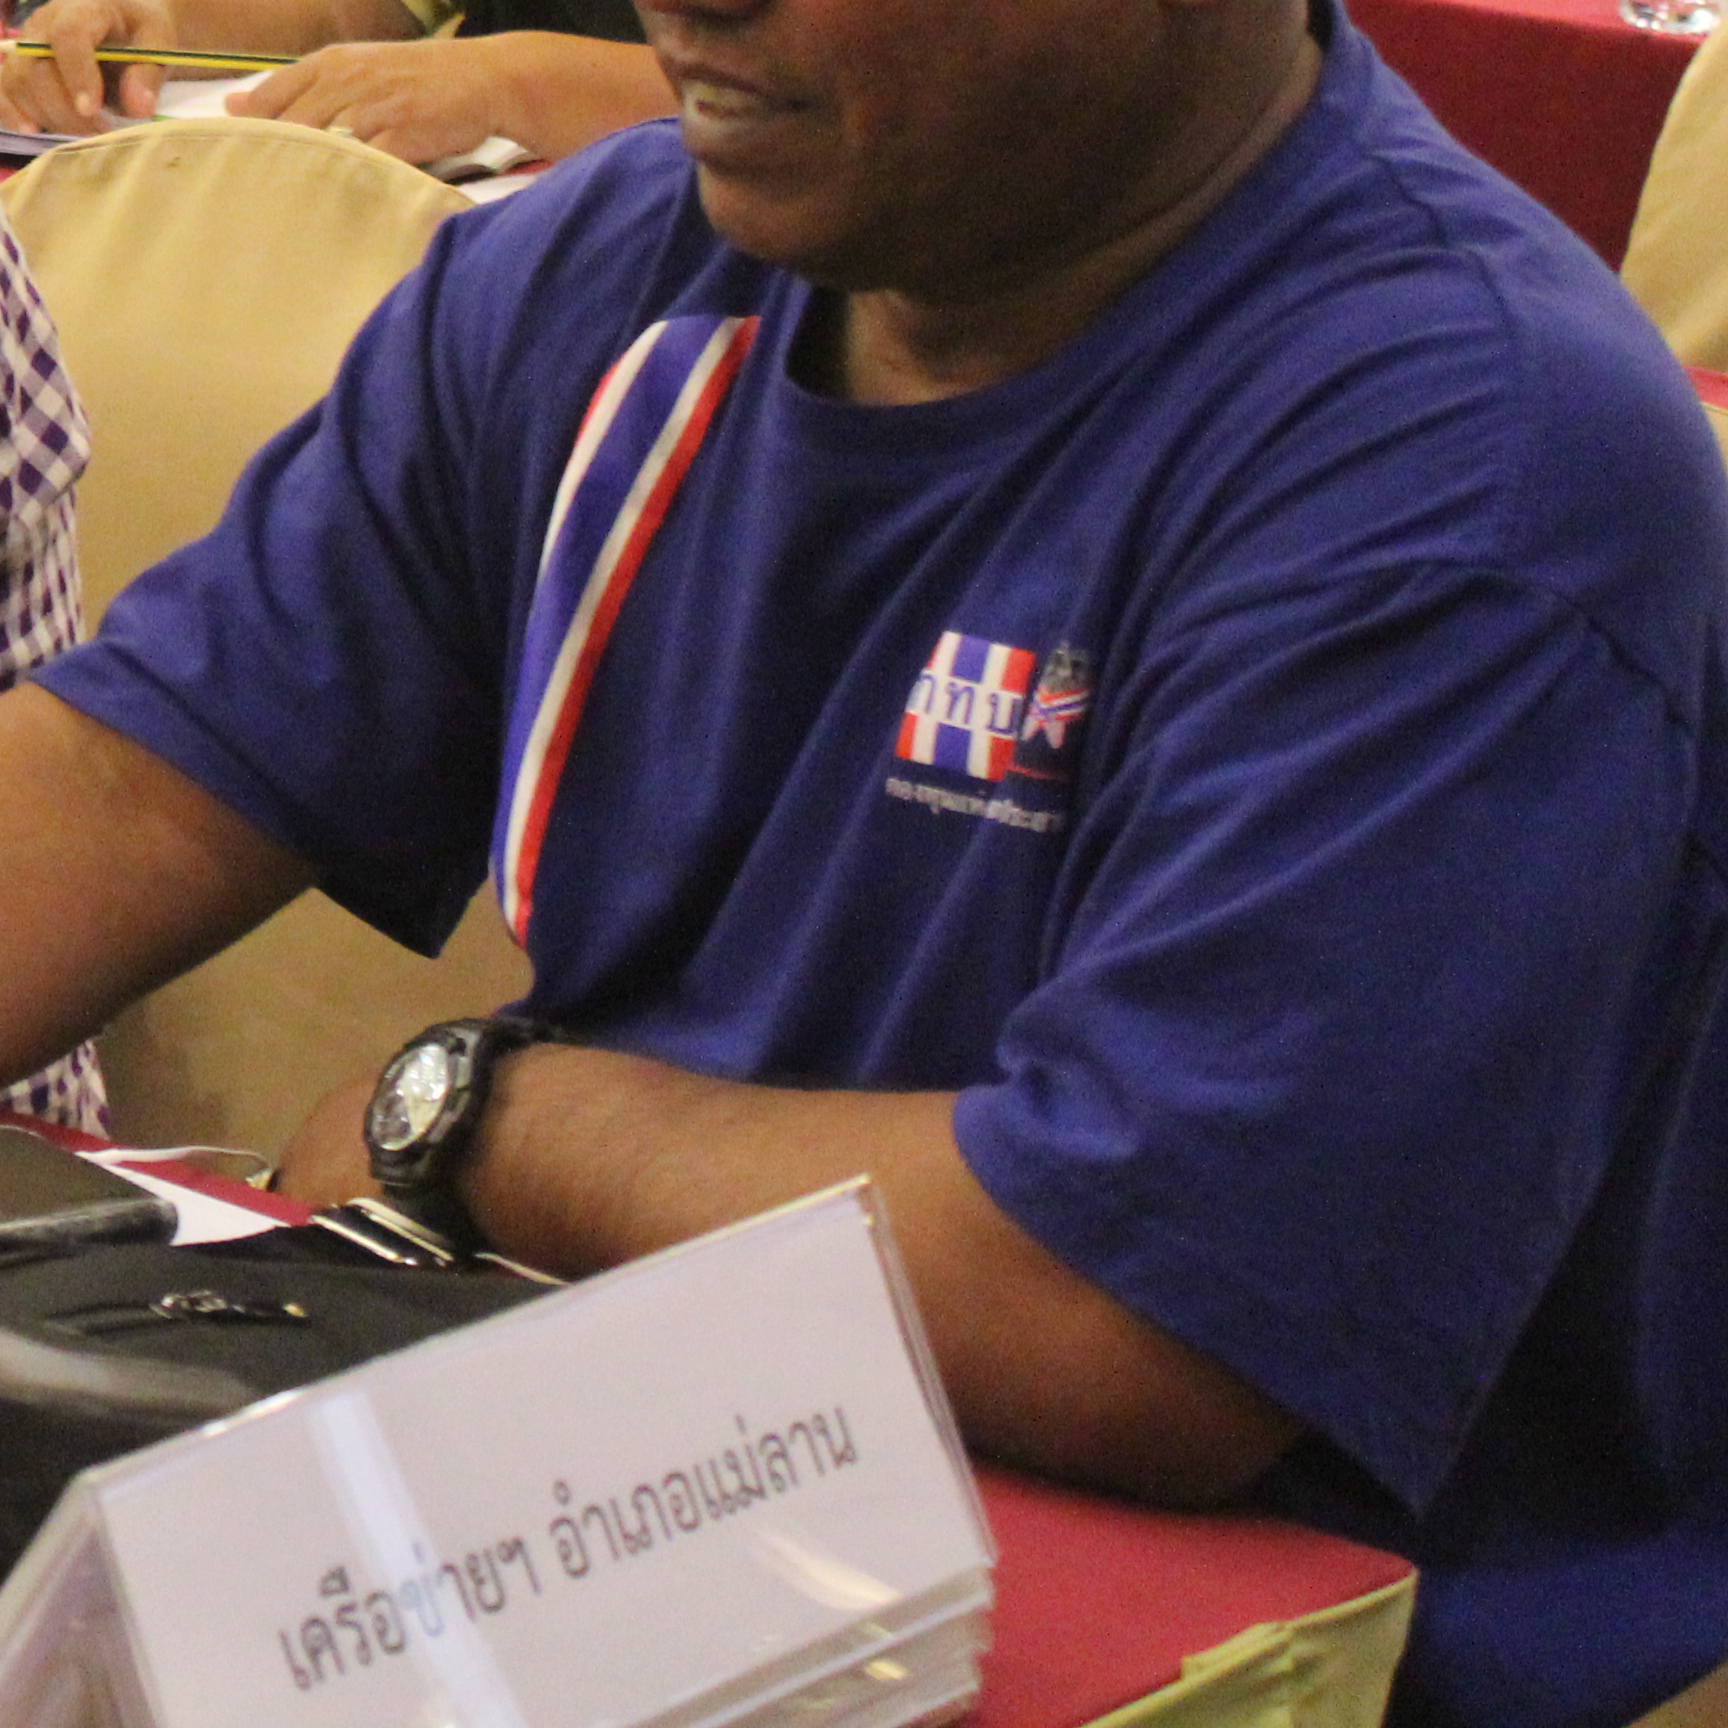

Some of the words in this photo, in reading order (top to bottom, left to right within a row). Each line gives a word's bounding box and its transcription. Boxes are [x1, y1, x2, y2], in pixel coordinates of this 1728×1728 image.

[278, 1536, 541, 1691] เครือข่ายฯ
[549, 1407, 858, 1578] อำเภอแม่ลาน
